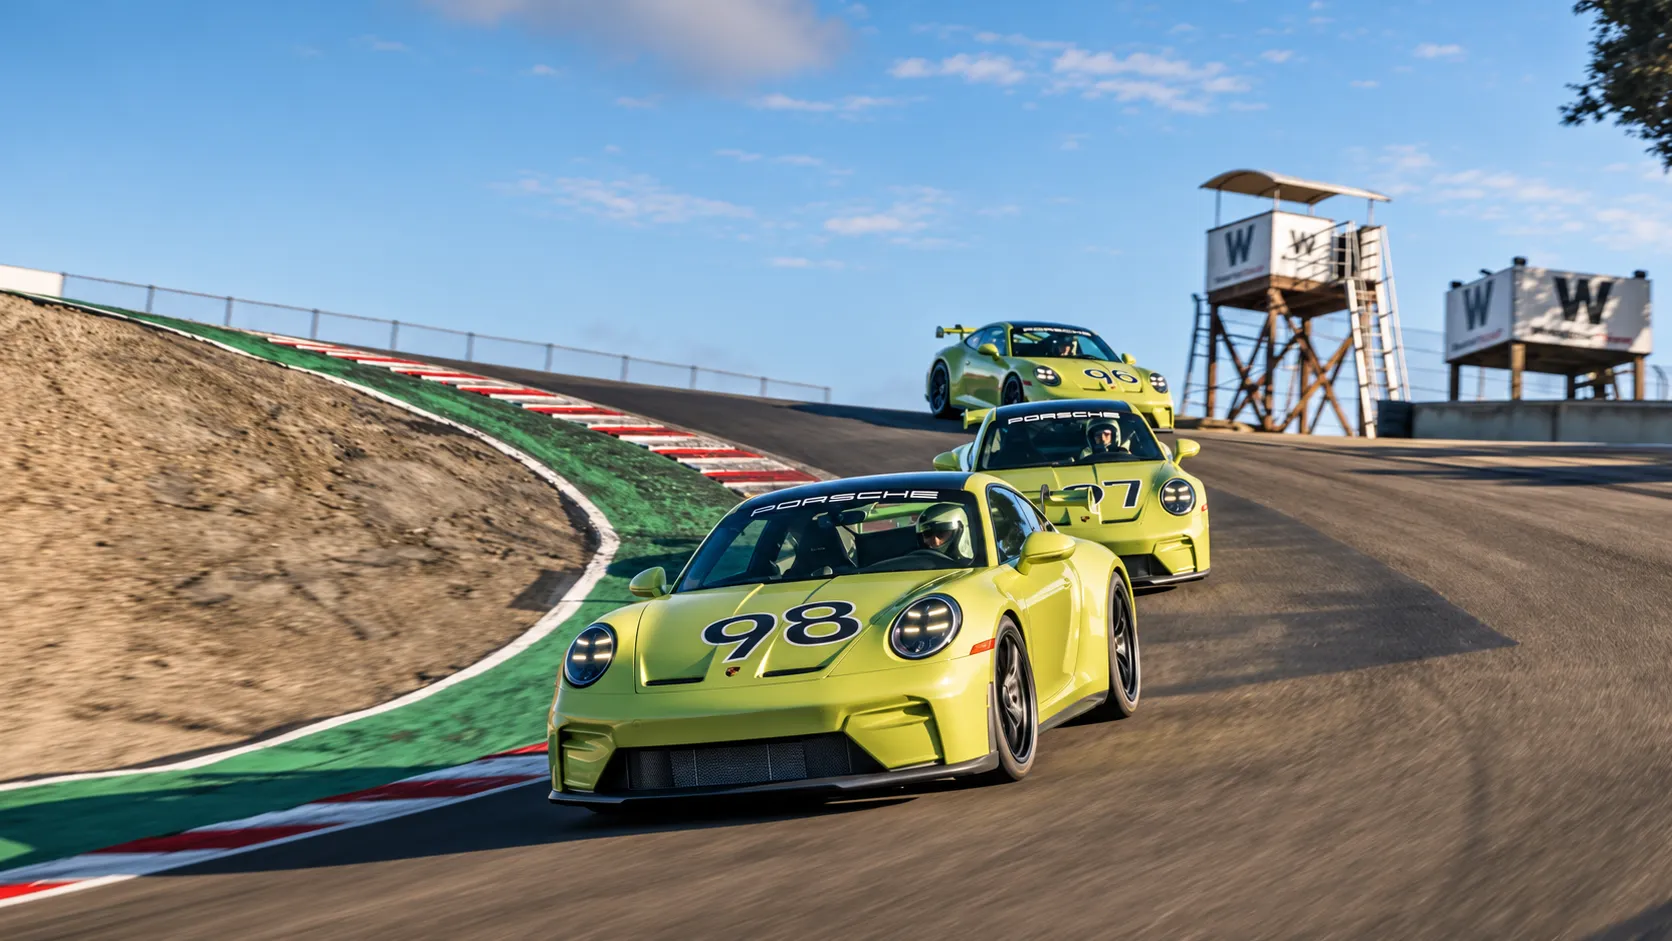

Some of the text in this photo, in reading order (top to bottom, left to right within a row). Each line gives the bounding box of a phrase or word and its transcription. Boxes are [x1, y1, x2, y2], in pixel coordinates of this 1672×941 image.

[1224, 224, 1256, 267] W
[1462, 278, 1495, 331] W
[1553, 276, 1614, 325] W
[1083, 368, 1138, 385] 96
[1008, 411, 1121, 425] PORSCHE
[750, 490, 939, 517] PORSCHE
[700, 600, 863, 664] 98
